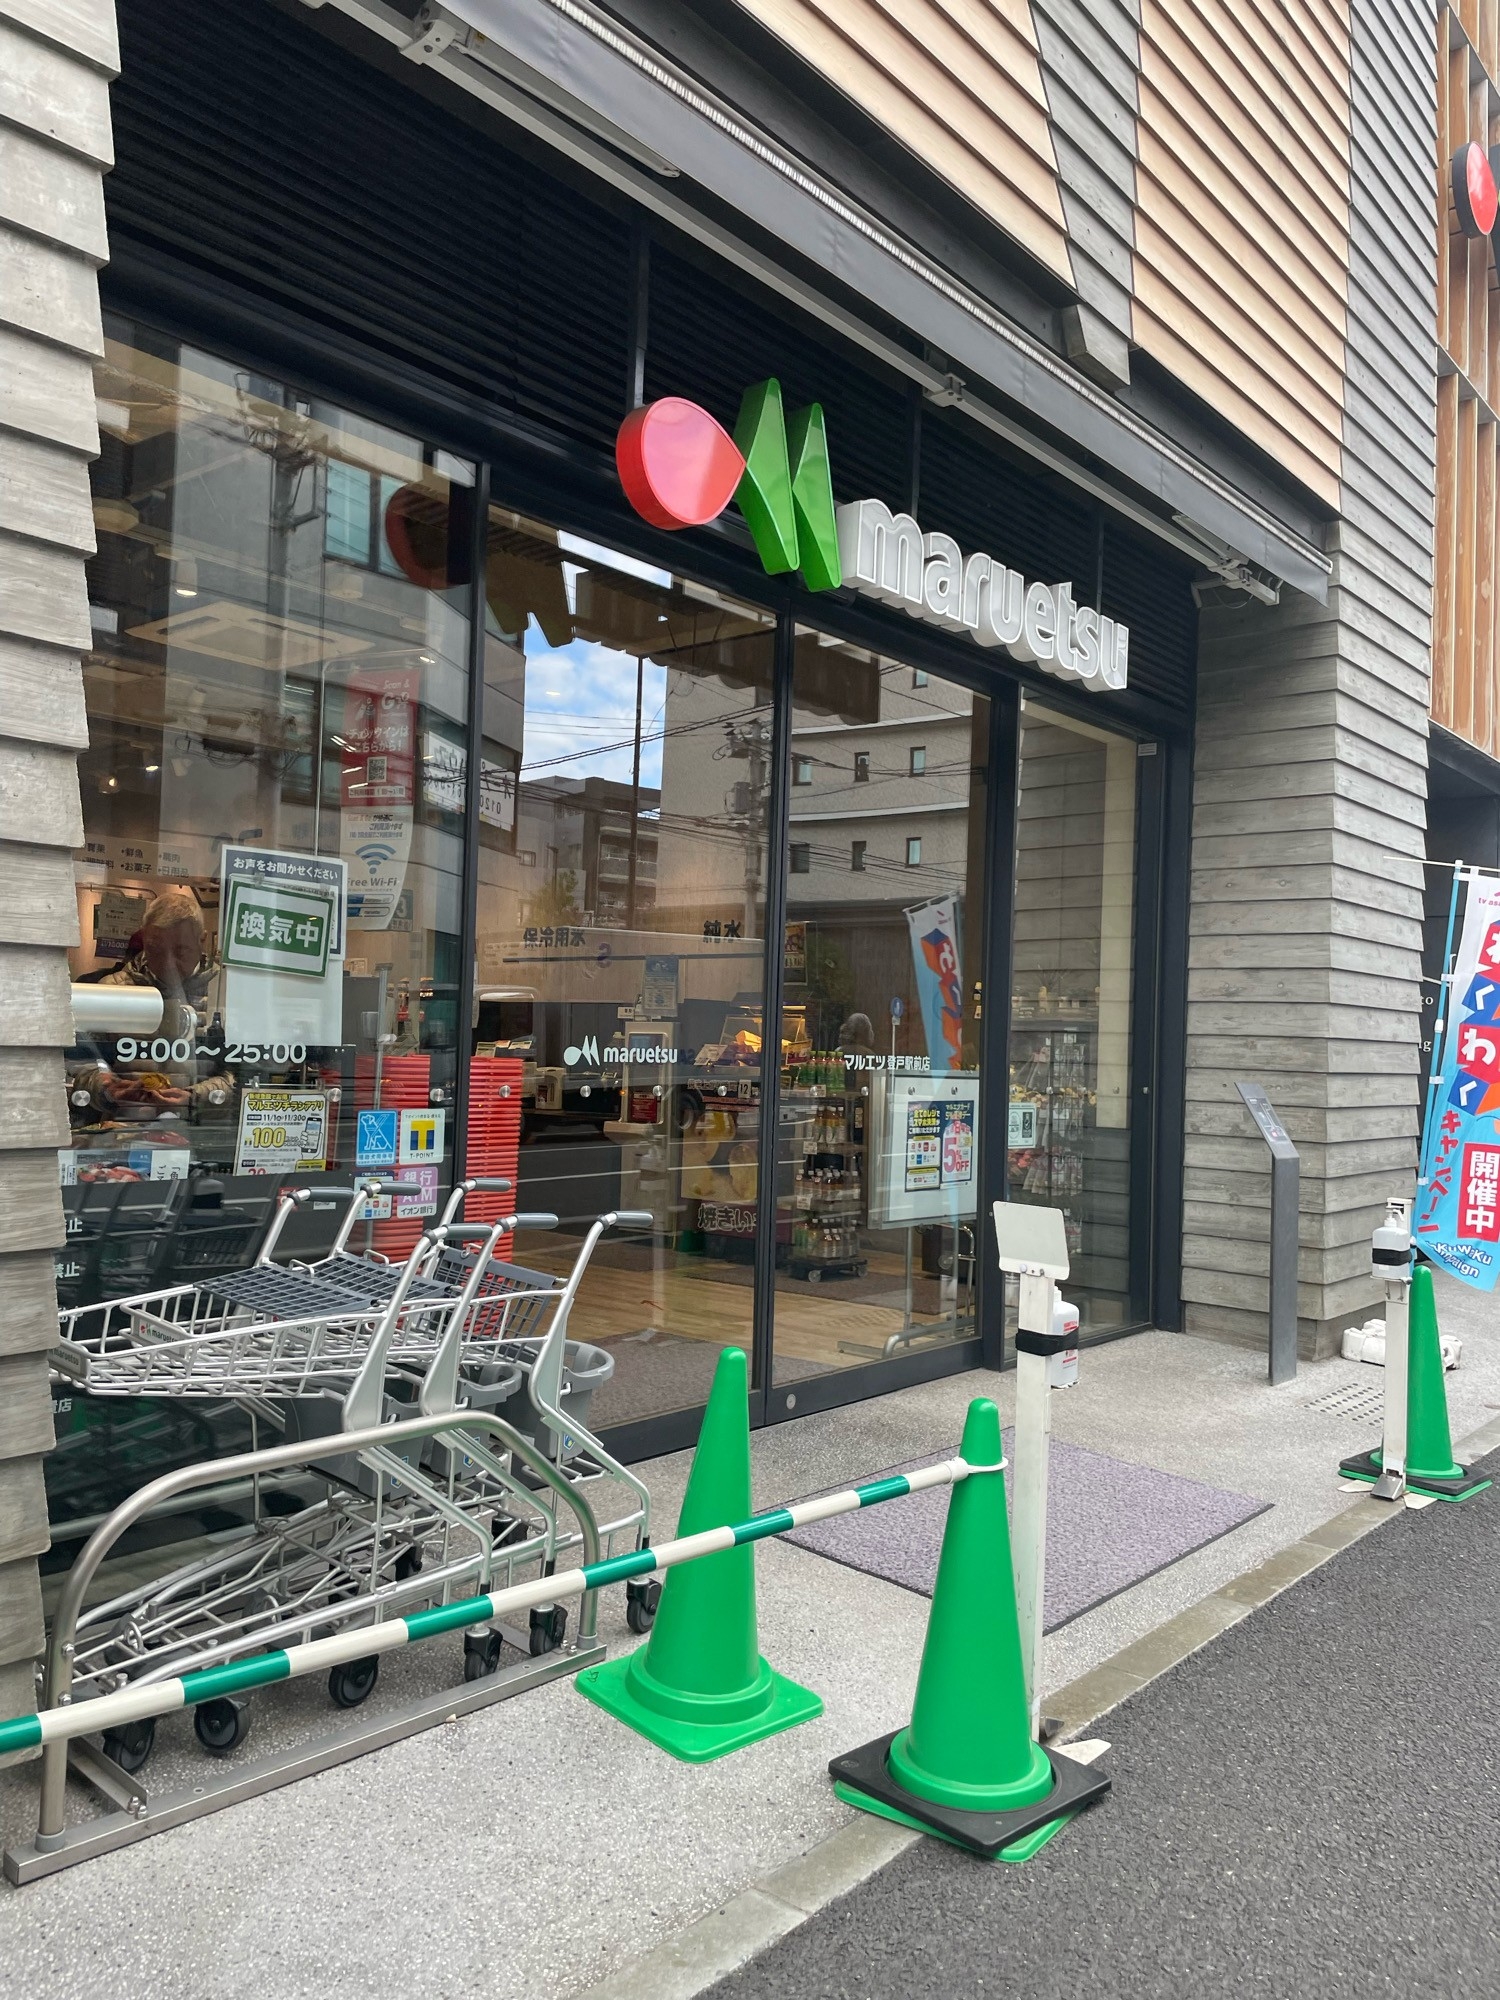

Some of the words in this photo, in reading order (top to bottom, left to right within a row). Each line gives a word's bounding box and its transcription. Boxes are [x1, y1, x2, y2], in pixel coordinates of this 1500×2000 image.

[842, 498, 1129, 692] maruetsu
[233, 857, 338, 880] お声をお聞かせください
[370, 877, 398, 887] Wi-Fi
[239, 910, 320, 948] 換気中
[603, 1044, 678, 1064] maruetsu
[739, 1083, 750, 1096] 12
[252, 1126, 287, 1149] 100
[956, 1160, 969, 1172] OFF
[1417, 1109, 1462, 1234] キャンペーン
[403, 1170, 433, 1186] 銀行
[1465, 1150, 1500, 1234] 開催中
[401, 1206, 433, 1217] イオン銀行
